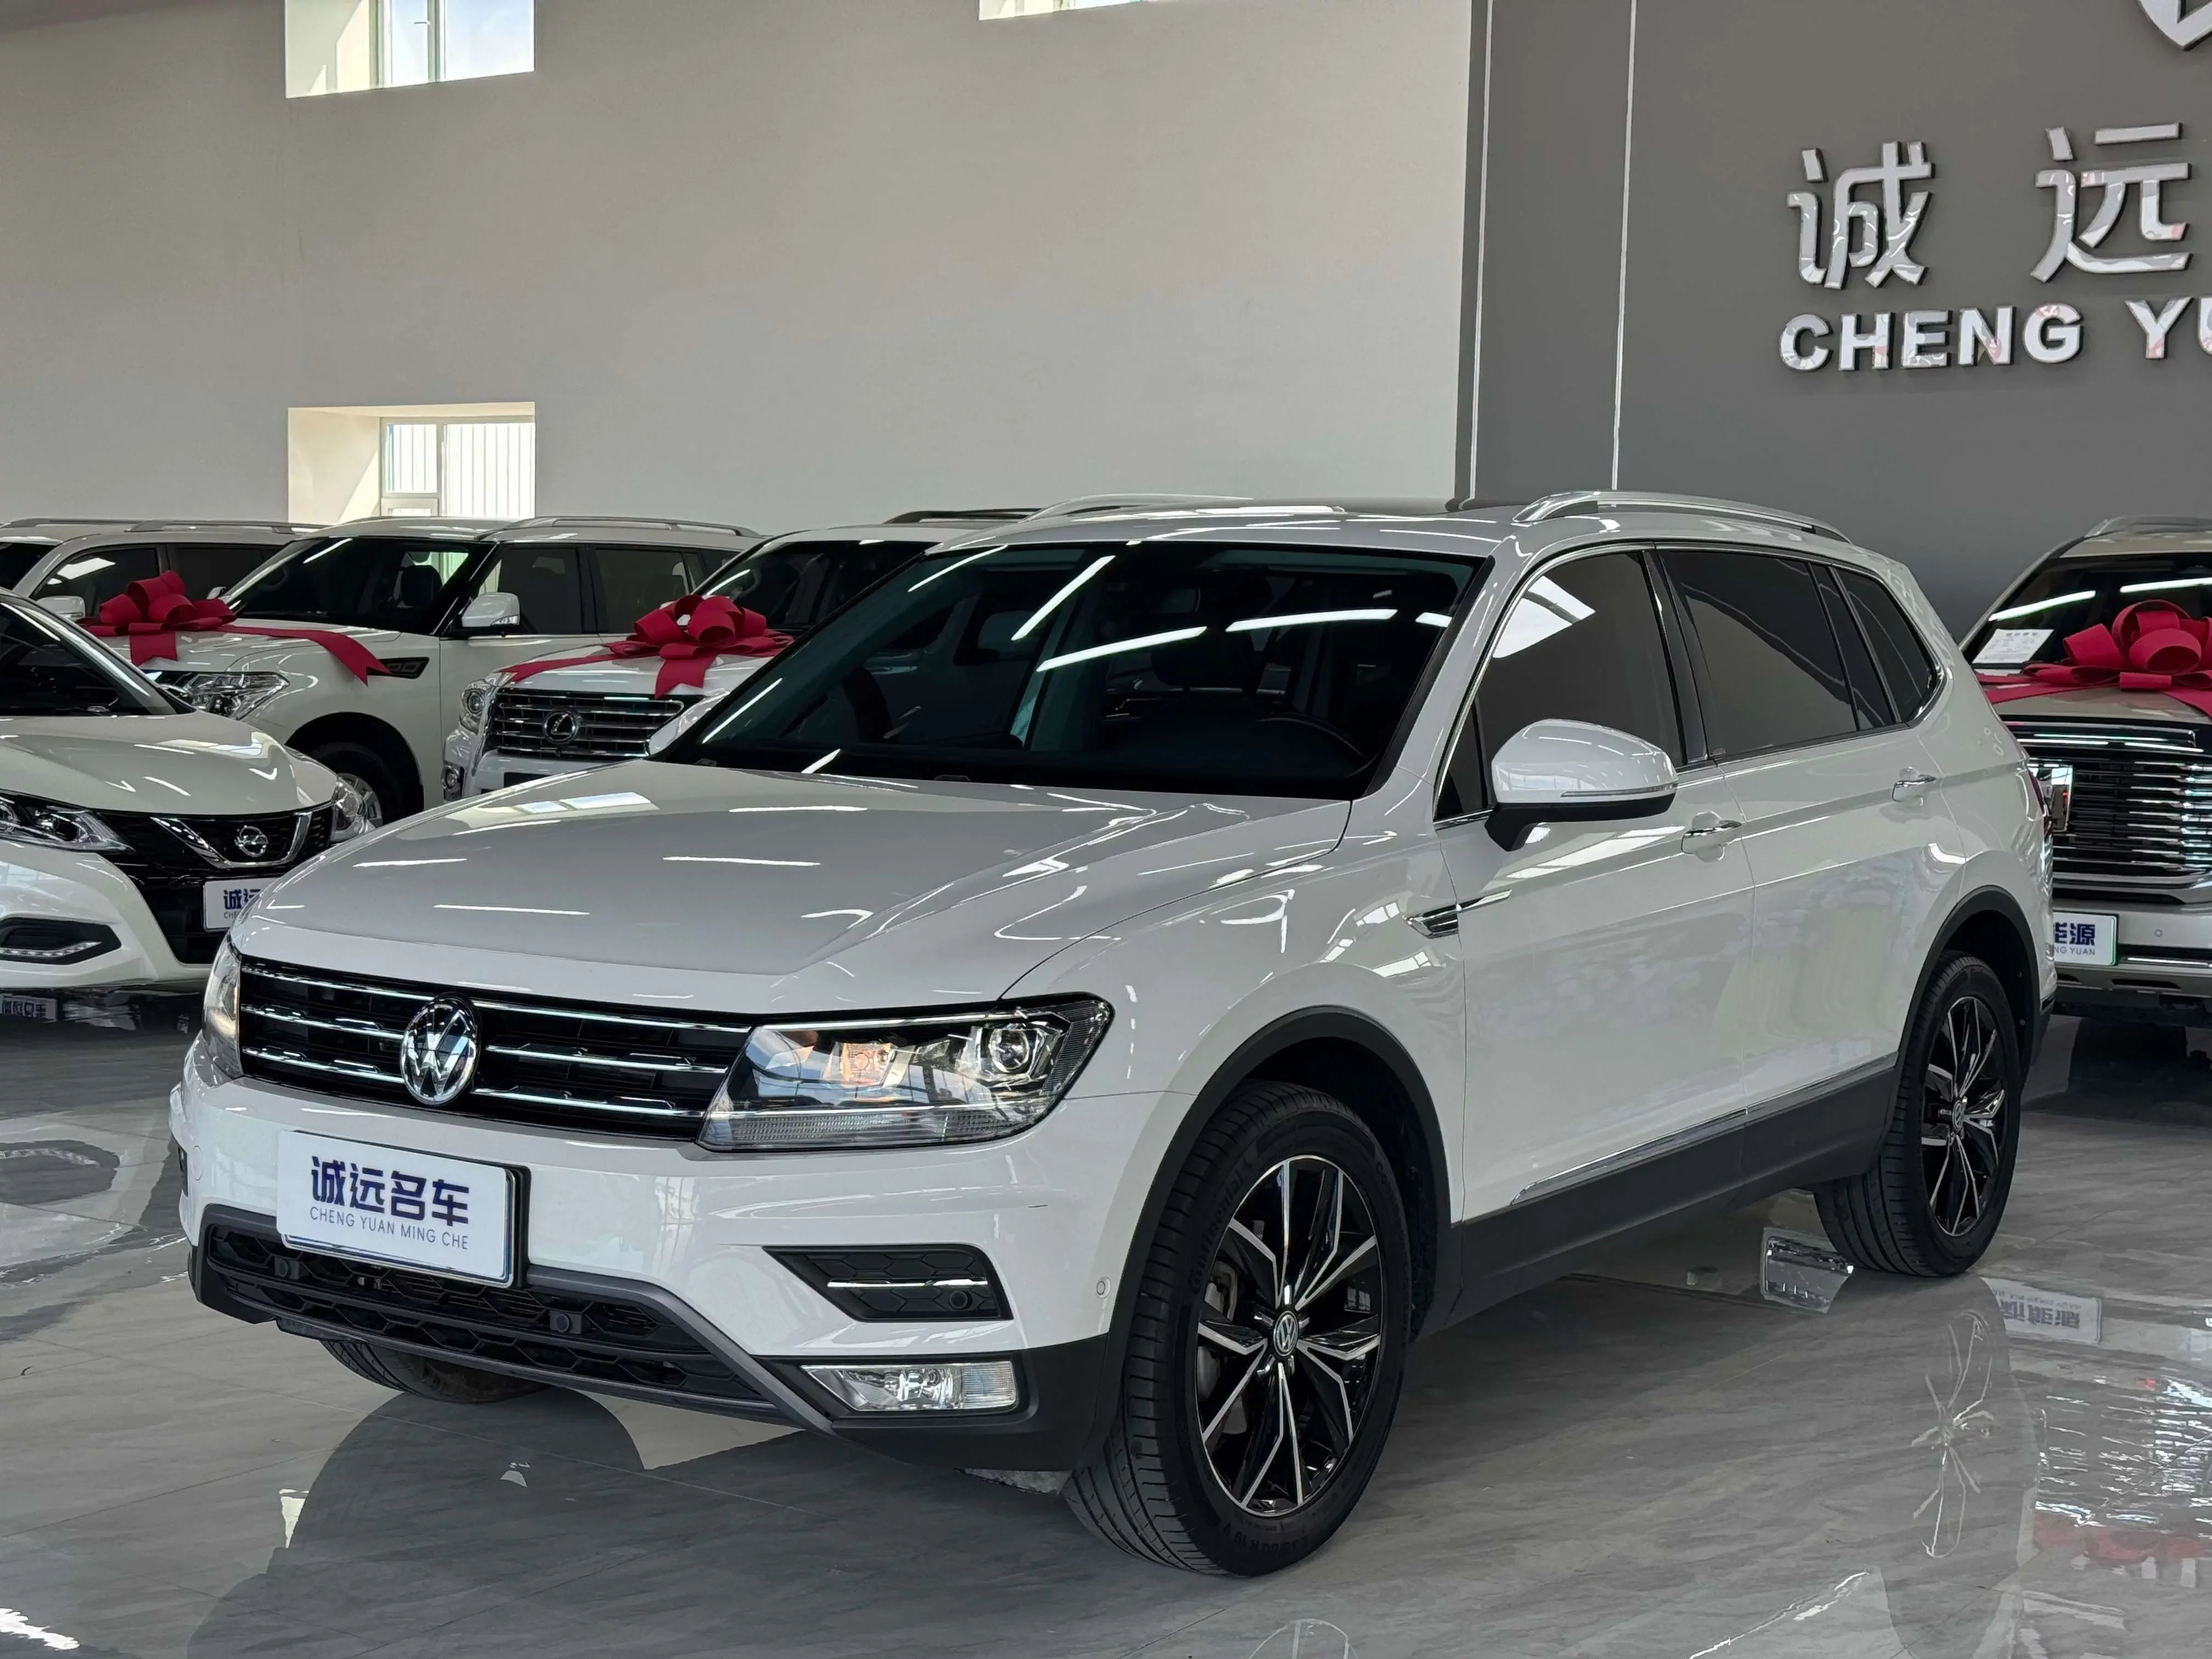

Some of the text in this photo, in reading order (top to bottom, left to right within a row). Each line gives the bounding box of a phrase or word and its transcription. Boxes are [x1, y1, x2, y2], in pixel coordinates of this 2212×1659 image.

[1779, 295, 2212, 372] CHENG Y
[2069, 947, 2095, 956] YUAN
[311, 1155, 470, 1227] 诚远名车
[309, 1206, 469, 1250] CHENG YUAN MING CHE
